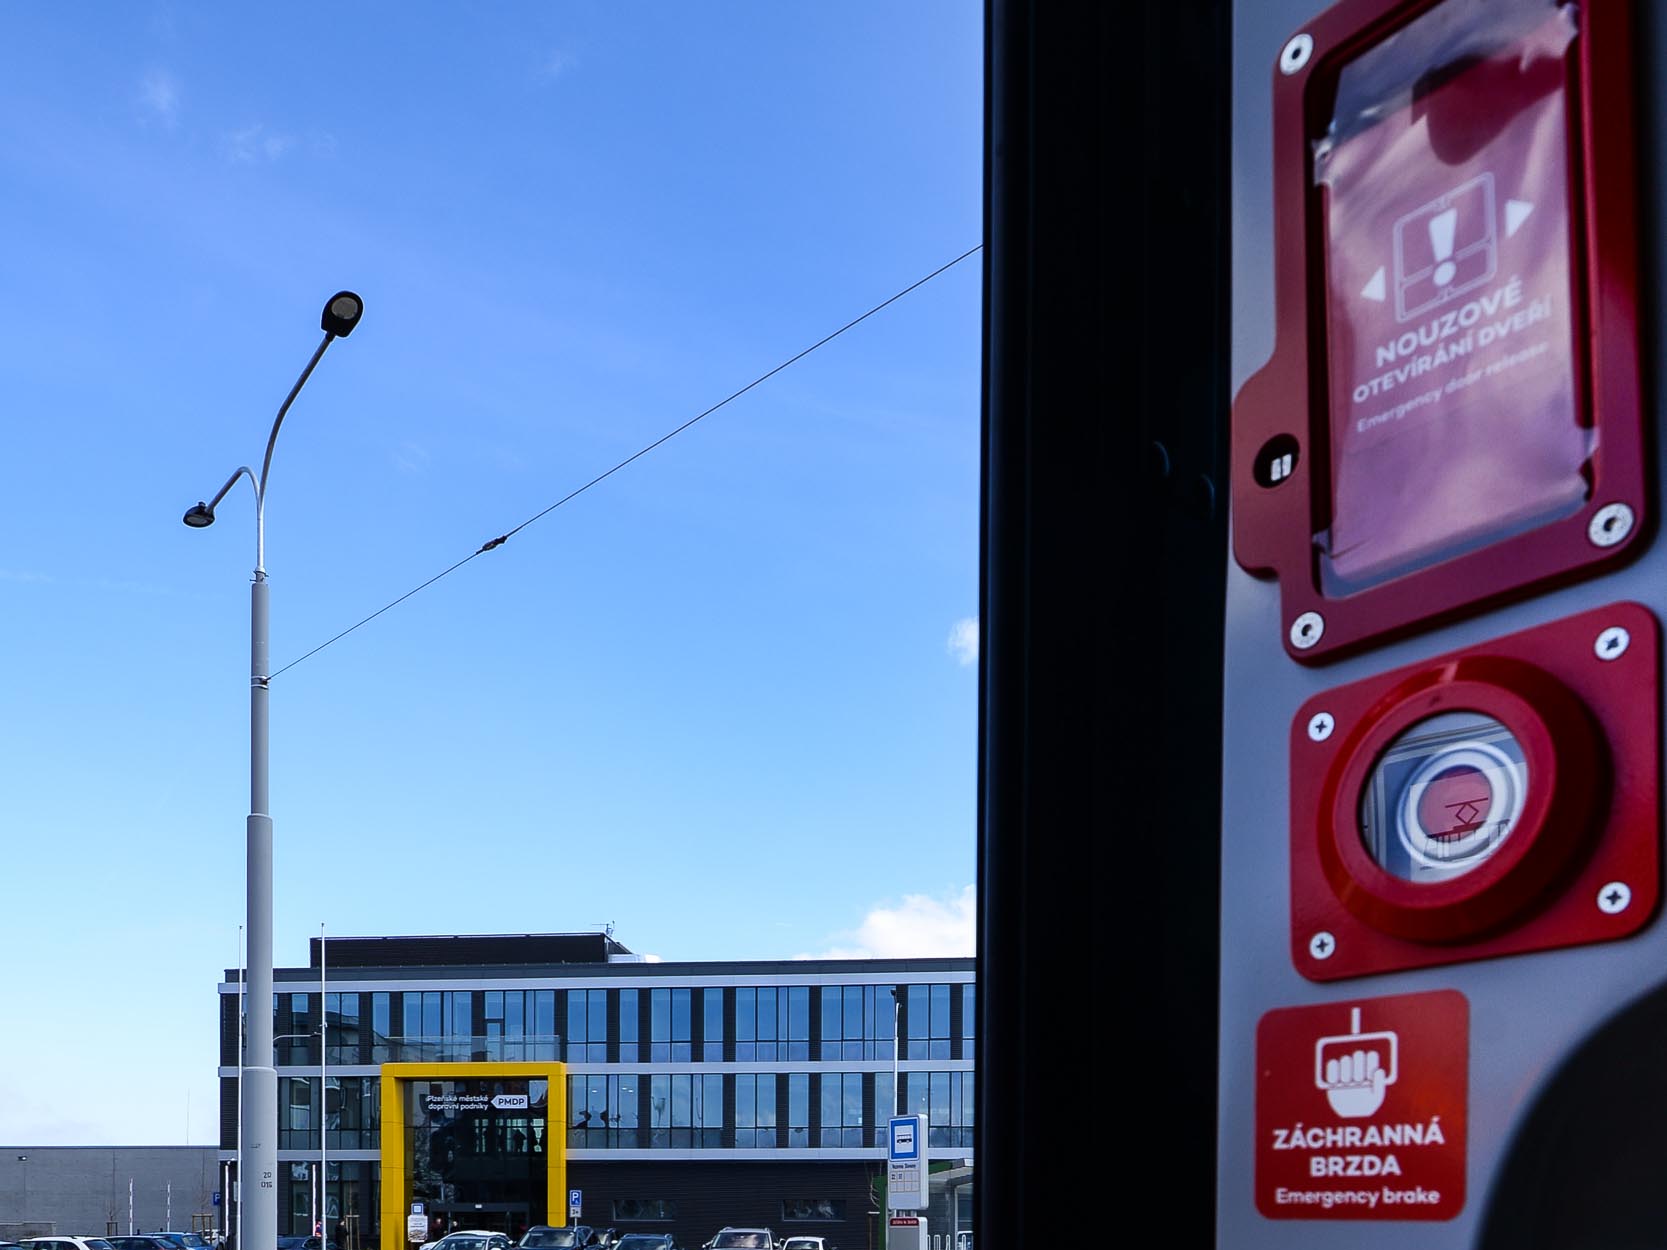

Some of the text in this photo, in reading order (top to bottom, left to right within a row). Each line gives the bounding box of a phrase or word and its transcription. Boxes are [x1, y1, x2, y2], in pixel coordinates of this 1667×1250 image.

[1375, 274, 1523, 368] NOUZOVÉ
[1353, 293, 1551, 404] OTEVÍRÁNÍ DVEŘÍ
[1357, 388, 1443, 432] Emergency
[426, 1094, 489, 1102] Plzeňské městské
[498, 1098, 525, 1106] PMDP
[1273, 1115, 1446, 1150] ZÁCHRANNÁ
[1310, 1154, 1402, 1177] BRZDA
[572, 1192, 579, 1202] P
[1275, 1186, 1441, 1209] Emergency brake
